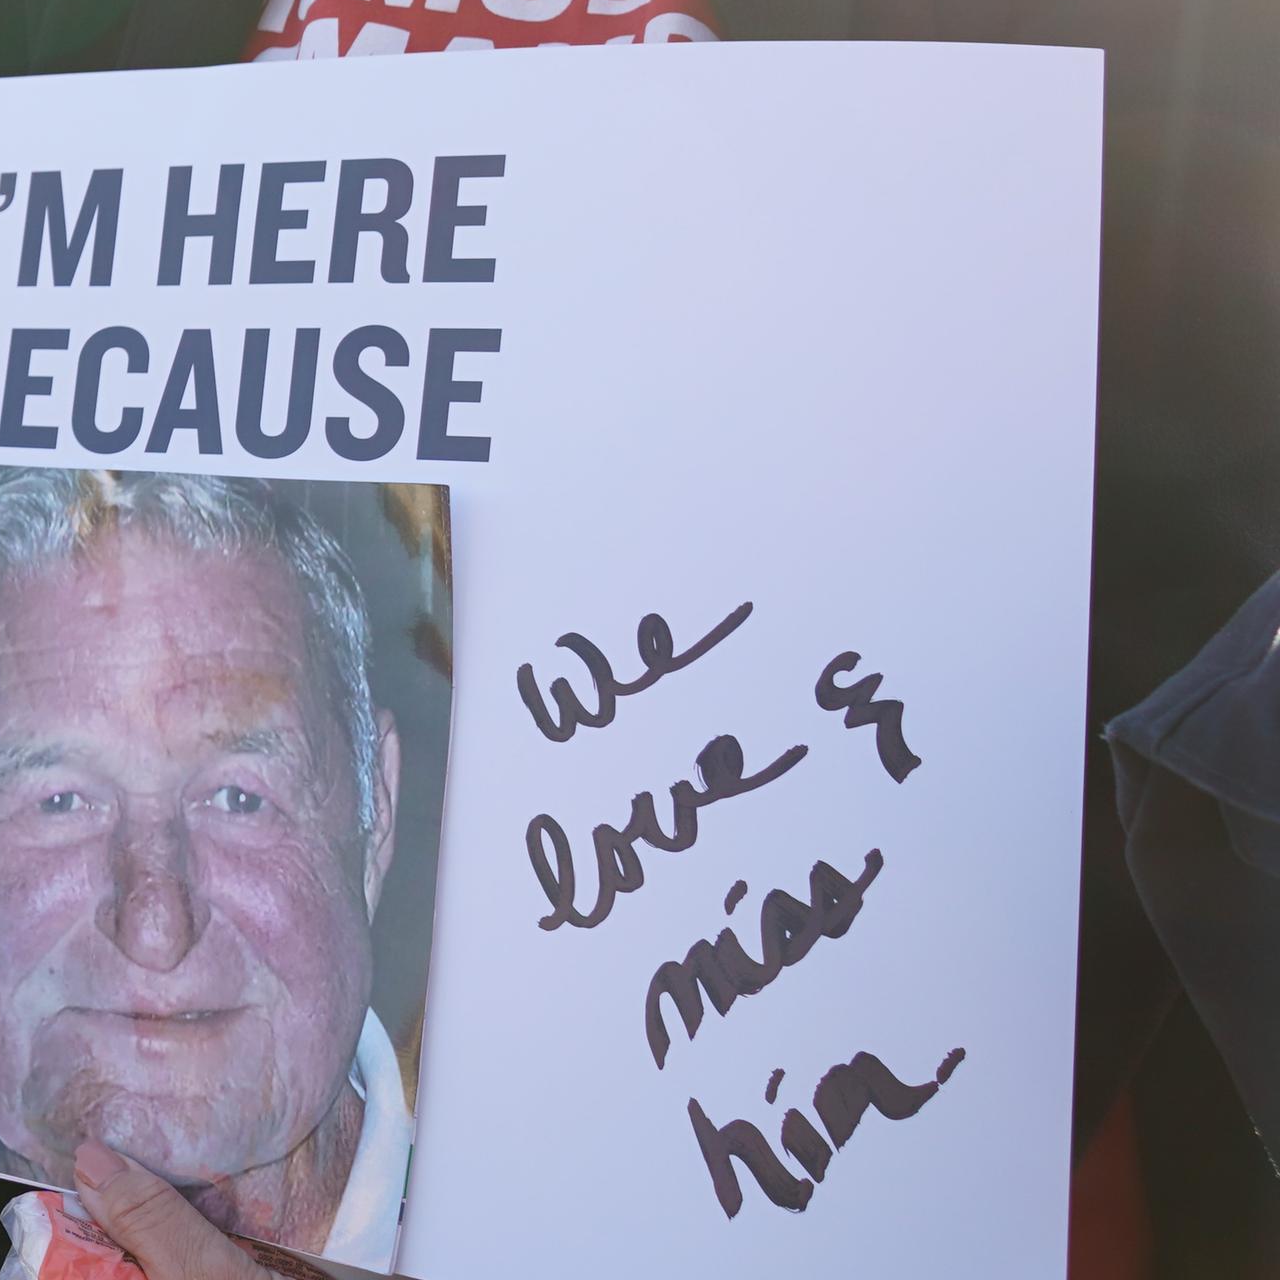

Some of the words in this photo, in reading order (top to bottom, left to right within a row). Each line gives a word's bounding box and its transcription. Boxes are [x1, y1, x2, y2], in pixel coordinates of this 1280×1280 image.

[156, 154, 507, 286] HERE
[525, 733, 809, 932] love
[645, 847, 884, 1070] miss
[686, 1047, 967, 1222] him
